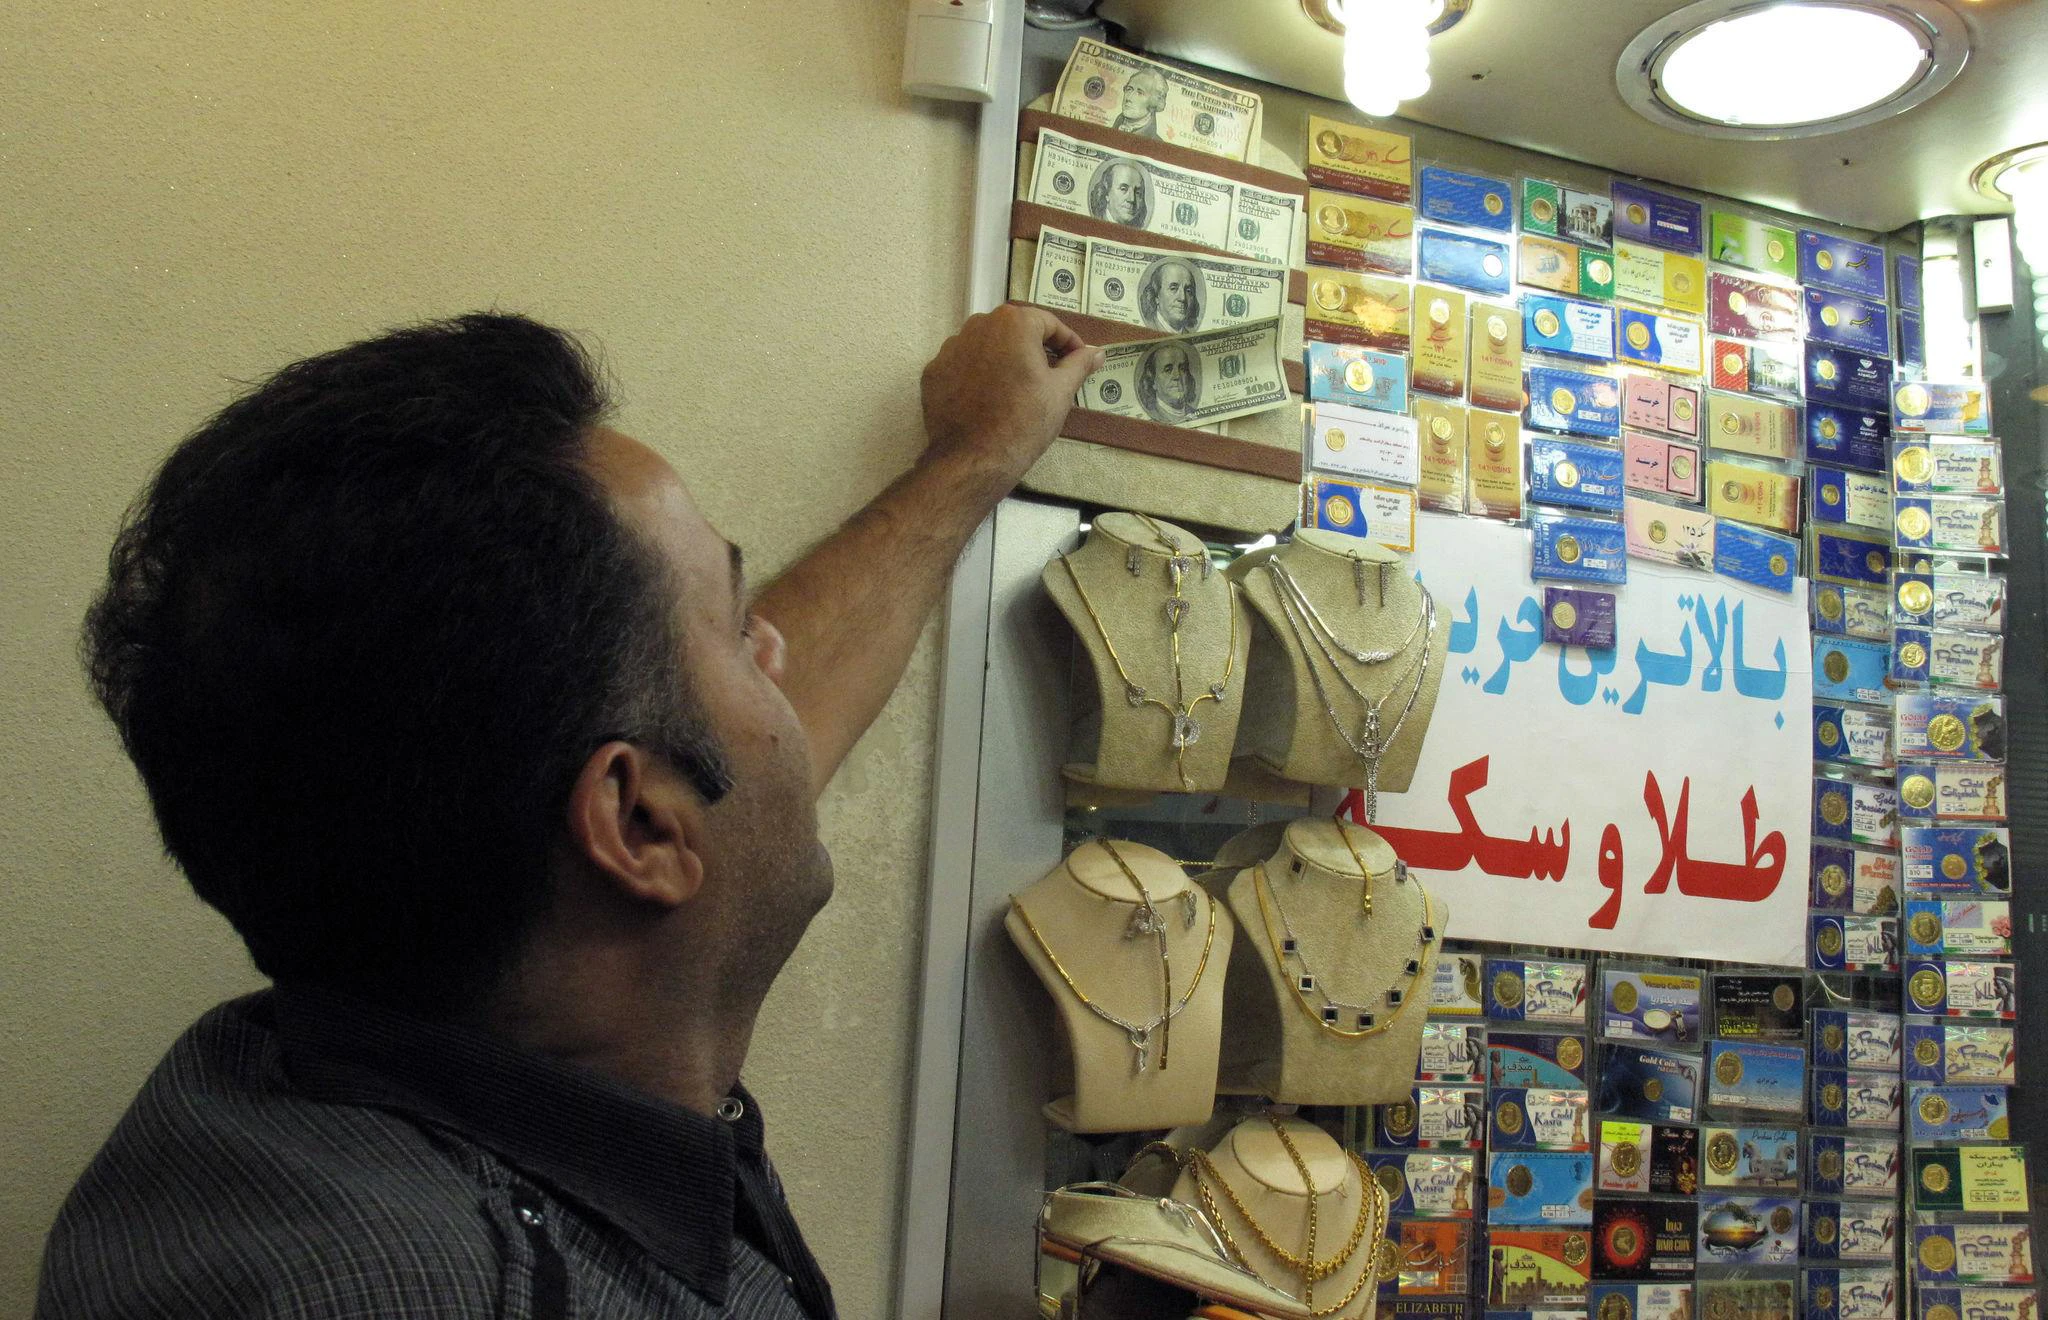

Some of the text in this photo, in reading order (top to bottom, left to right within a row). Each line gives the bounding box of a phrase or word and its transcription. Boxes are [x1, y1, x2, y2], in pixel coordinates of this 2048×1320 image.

[1244, 380, 1276, 395] 100
[1194, 393, 1281, 416] ONE HUNDRED DOLLARS
[1643, 770, 1787, 902] طلا
[1588, 823, 1624, 930] و
[1640, 1054, 1658, 1064] Gold
[1534, 1112, 1562, 1127] Kasra
[1414, 1178, 1444, 1193] Kasra
[1431, 1174, 1456, 1186] Gold
[1510, 1260, 1537, 1270] صدف
[1396, 1303, 1464, 1314] ELIZABETH
